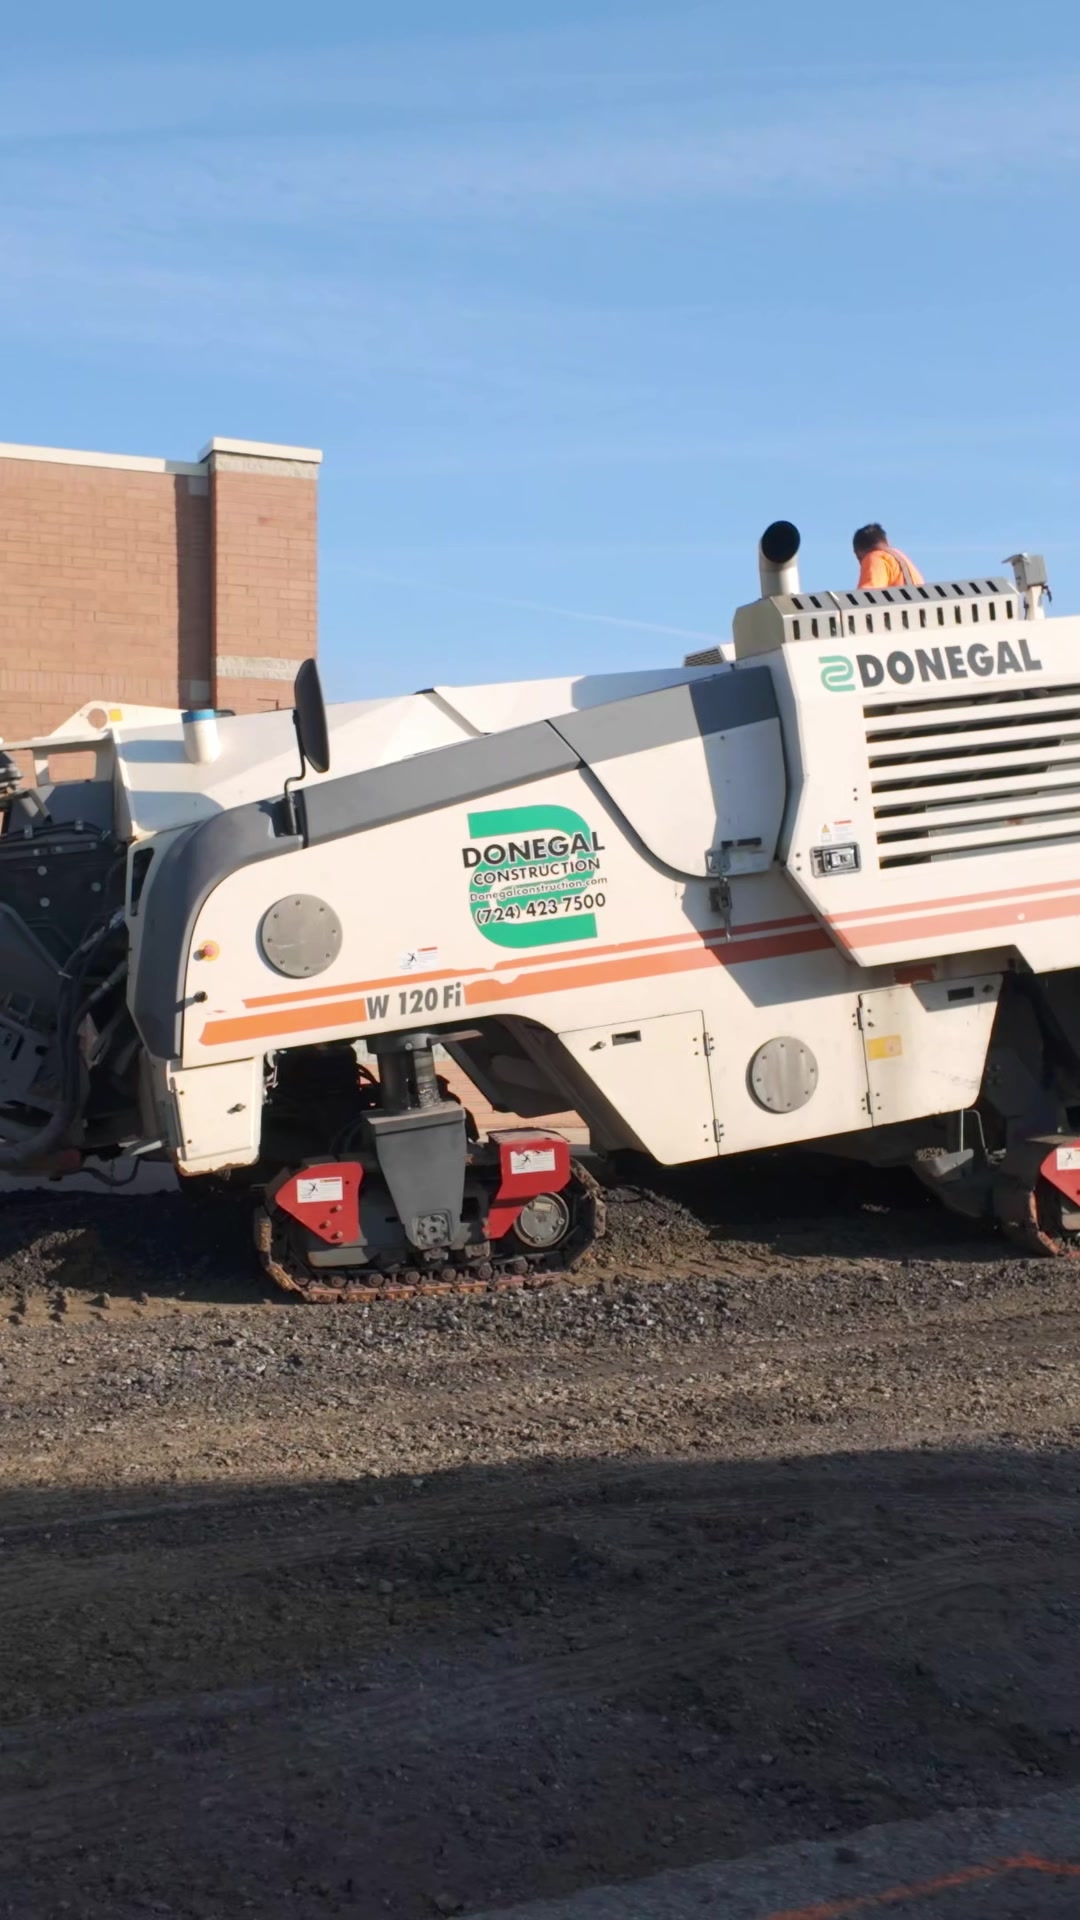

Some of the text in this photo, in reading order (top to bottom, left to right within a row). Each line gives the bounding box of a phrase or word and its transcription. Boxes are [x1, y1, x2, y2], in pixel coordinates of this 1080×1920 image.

[856, 639, 1042, 688] DONEGAL
[462, 832, 605, 868] DONEGAL
[474, 858, 600, 885] CONSTRUCTION
[476, 893, 606, 924] (724) 423 7500
[367, 982, 461, 1020] W 120 Fi
